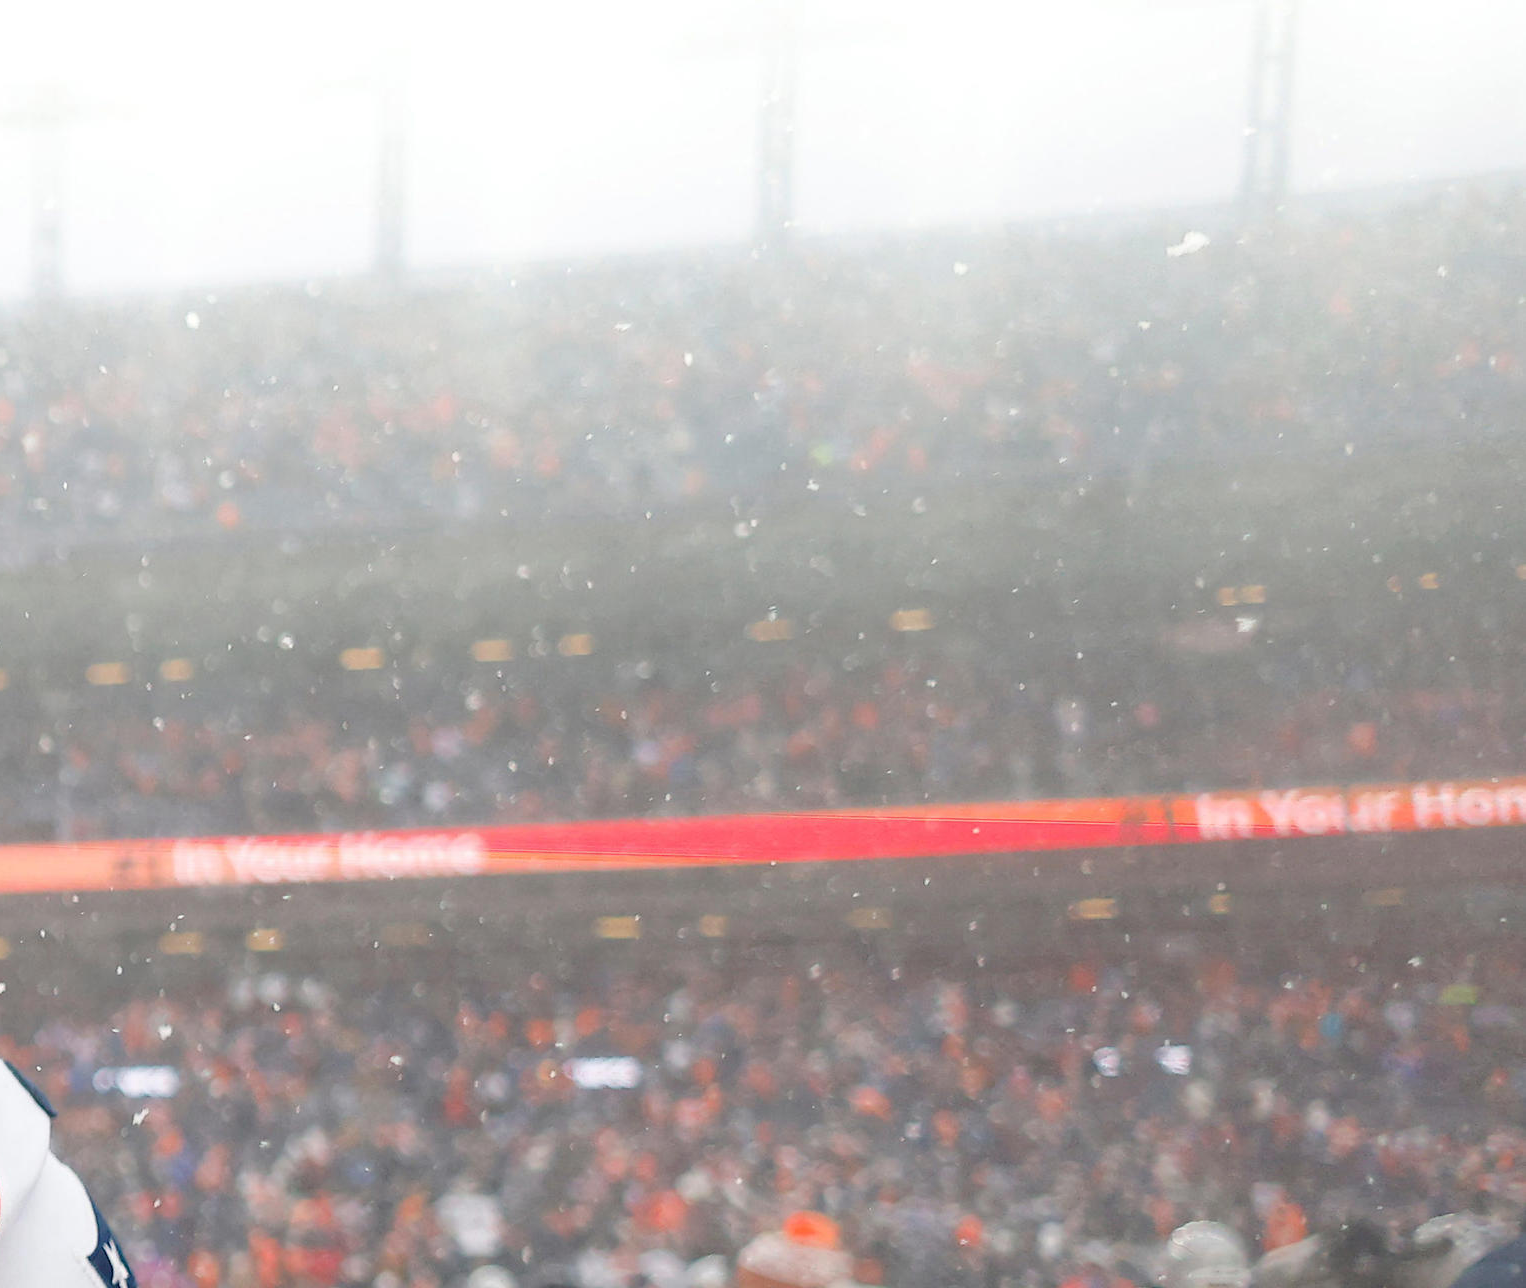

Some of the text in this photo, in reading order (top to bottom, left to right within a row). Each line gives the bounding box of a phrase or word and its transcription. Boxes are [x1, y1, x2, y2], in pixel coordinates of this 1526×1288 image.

[1194, 792, 1255, 840] In
[1259, 788, 1402, 838] Your
[338, 829, 487, 880] Home
